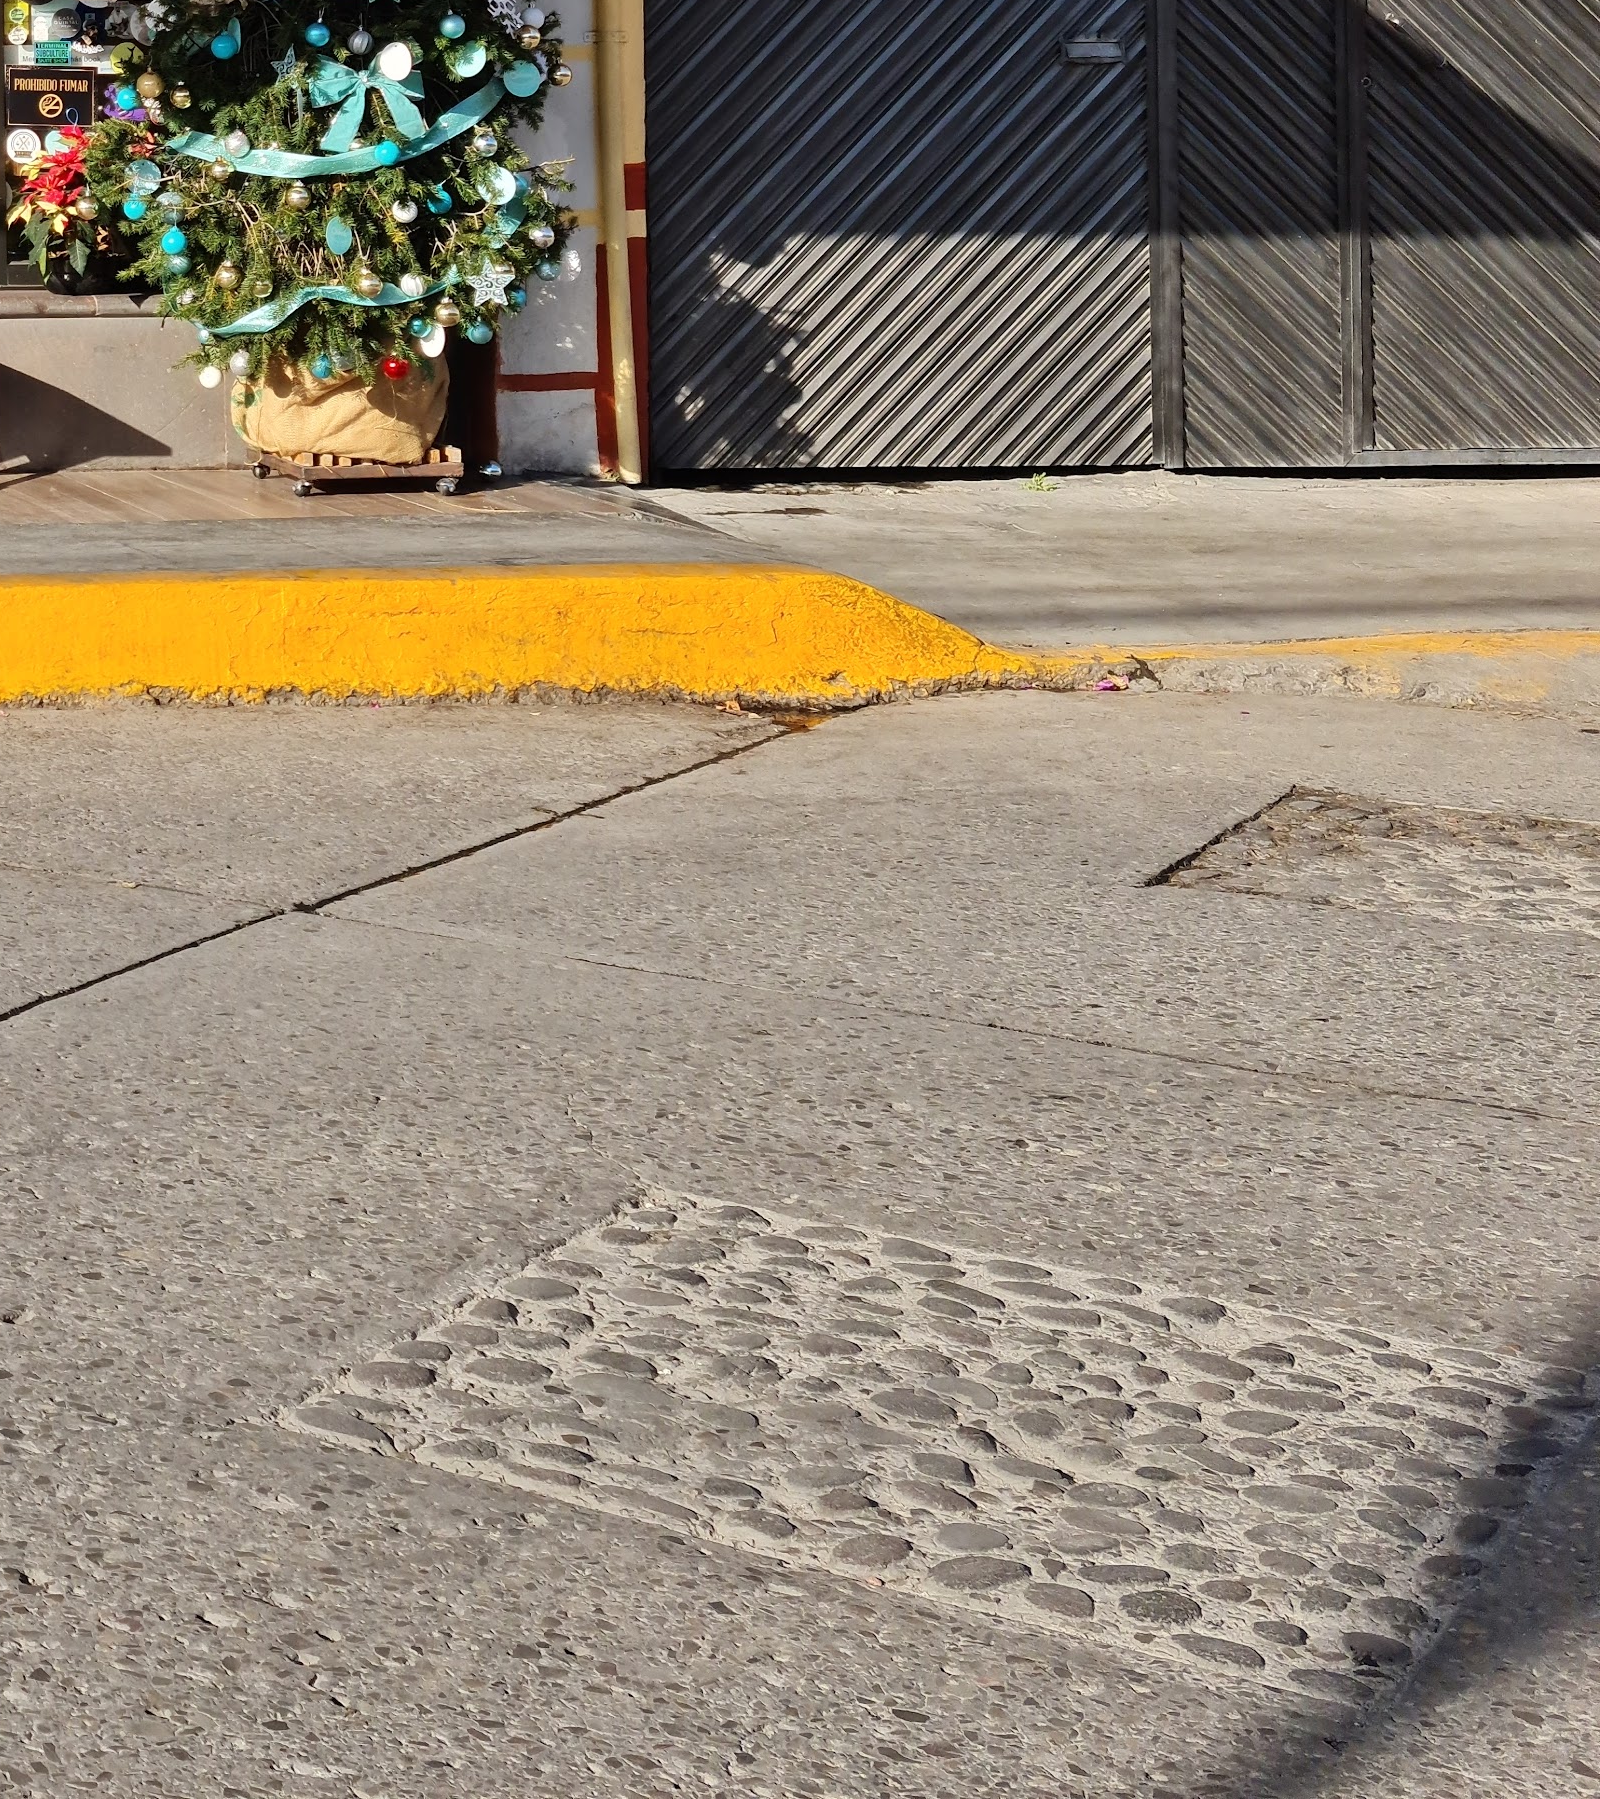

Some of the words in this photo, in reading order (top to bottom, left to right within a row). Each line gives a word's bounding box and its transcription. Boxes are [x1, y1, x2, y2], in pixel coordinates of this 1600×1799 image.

[36, 49, 69, 58] SUBCULTURE
[14, 78, 58, 92] PROHIBIDO
[59, 79, 89, 93] FUMAR
